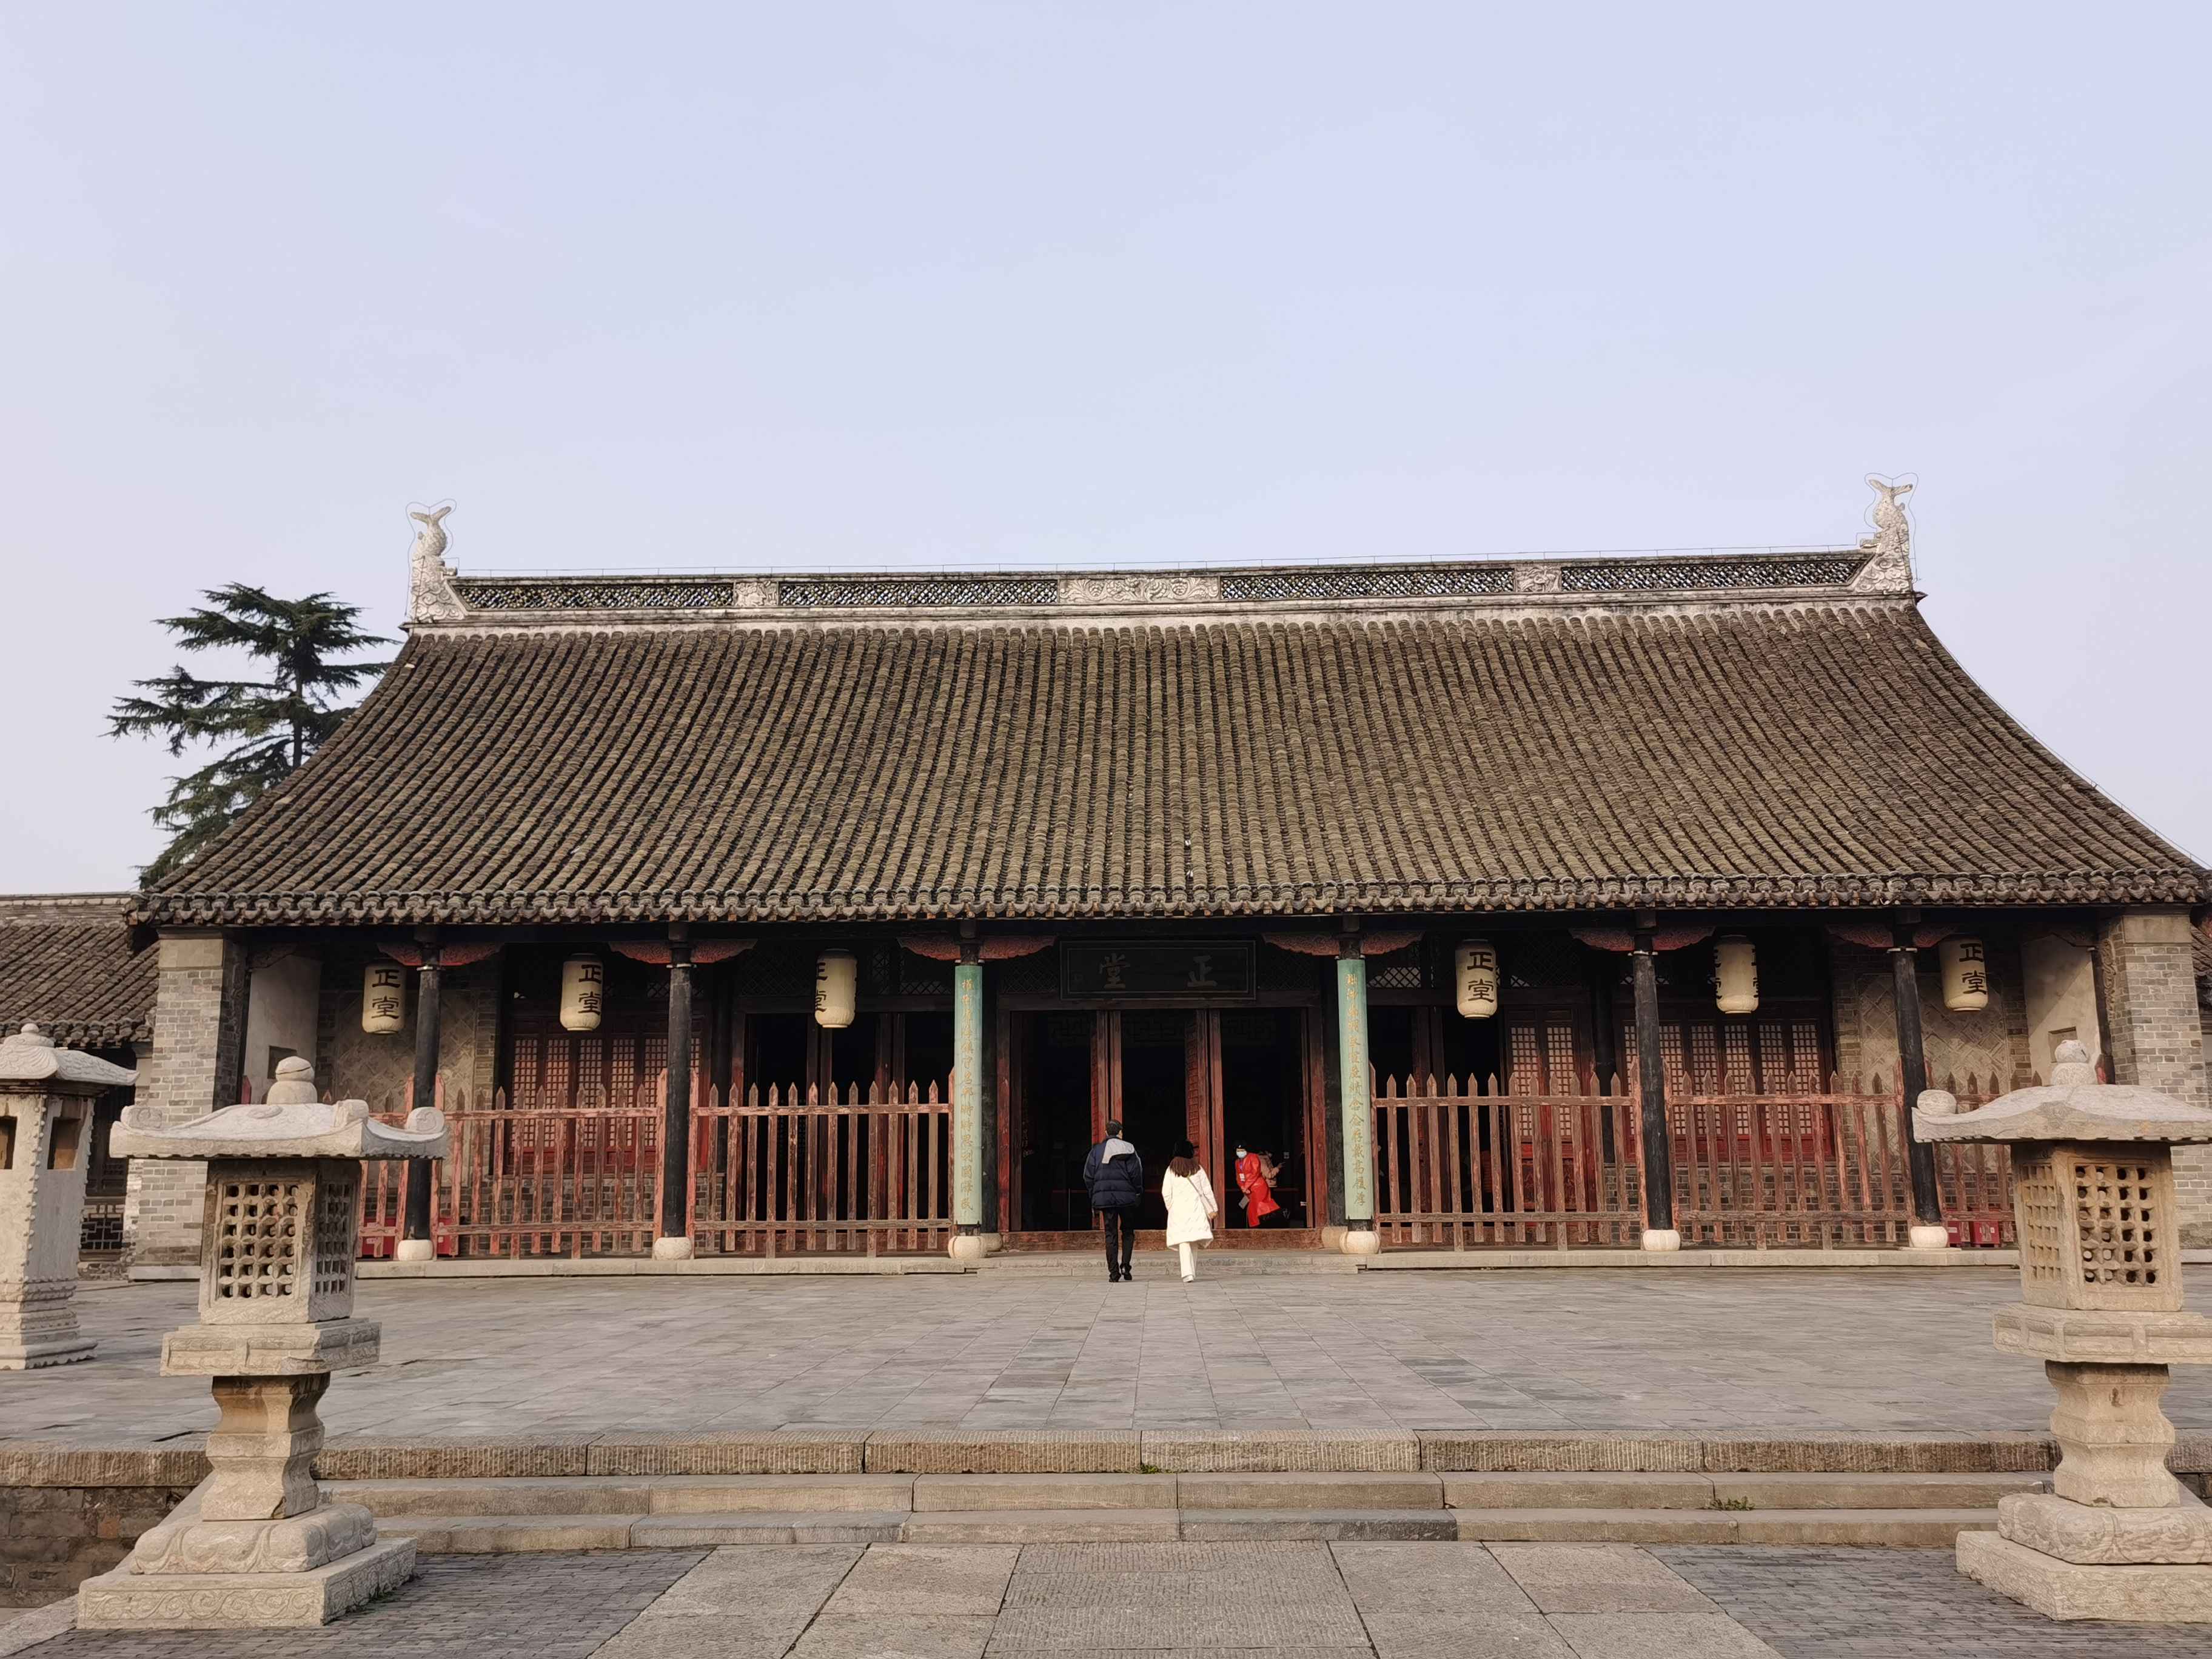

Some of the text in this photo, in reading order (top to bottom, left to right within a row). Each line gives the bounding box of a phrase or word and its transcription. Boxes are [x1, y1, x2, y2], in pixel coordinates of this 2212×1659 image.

[372, 968, 400, 1020] 正堂
[578, 964, 602, 1016] 正堂
[1467, 951, 1495, 1003] 正堂
[1959, 943, 1987, 995] 正堂
